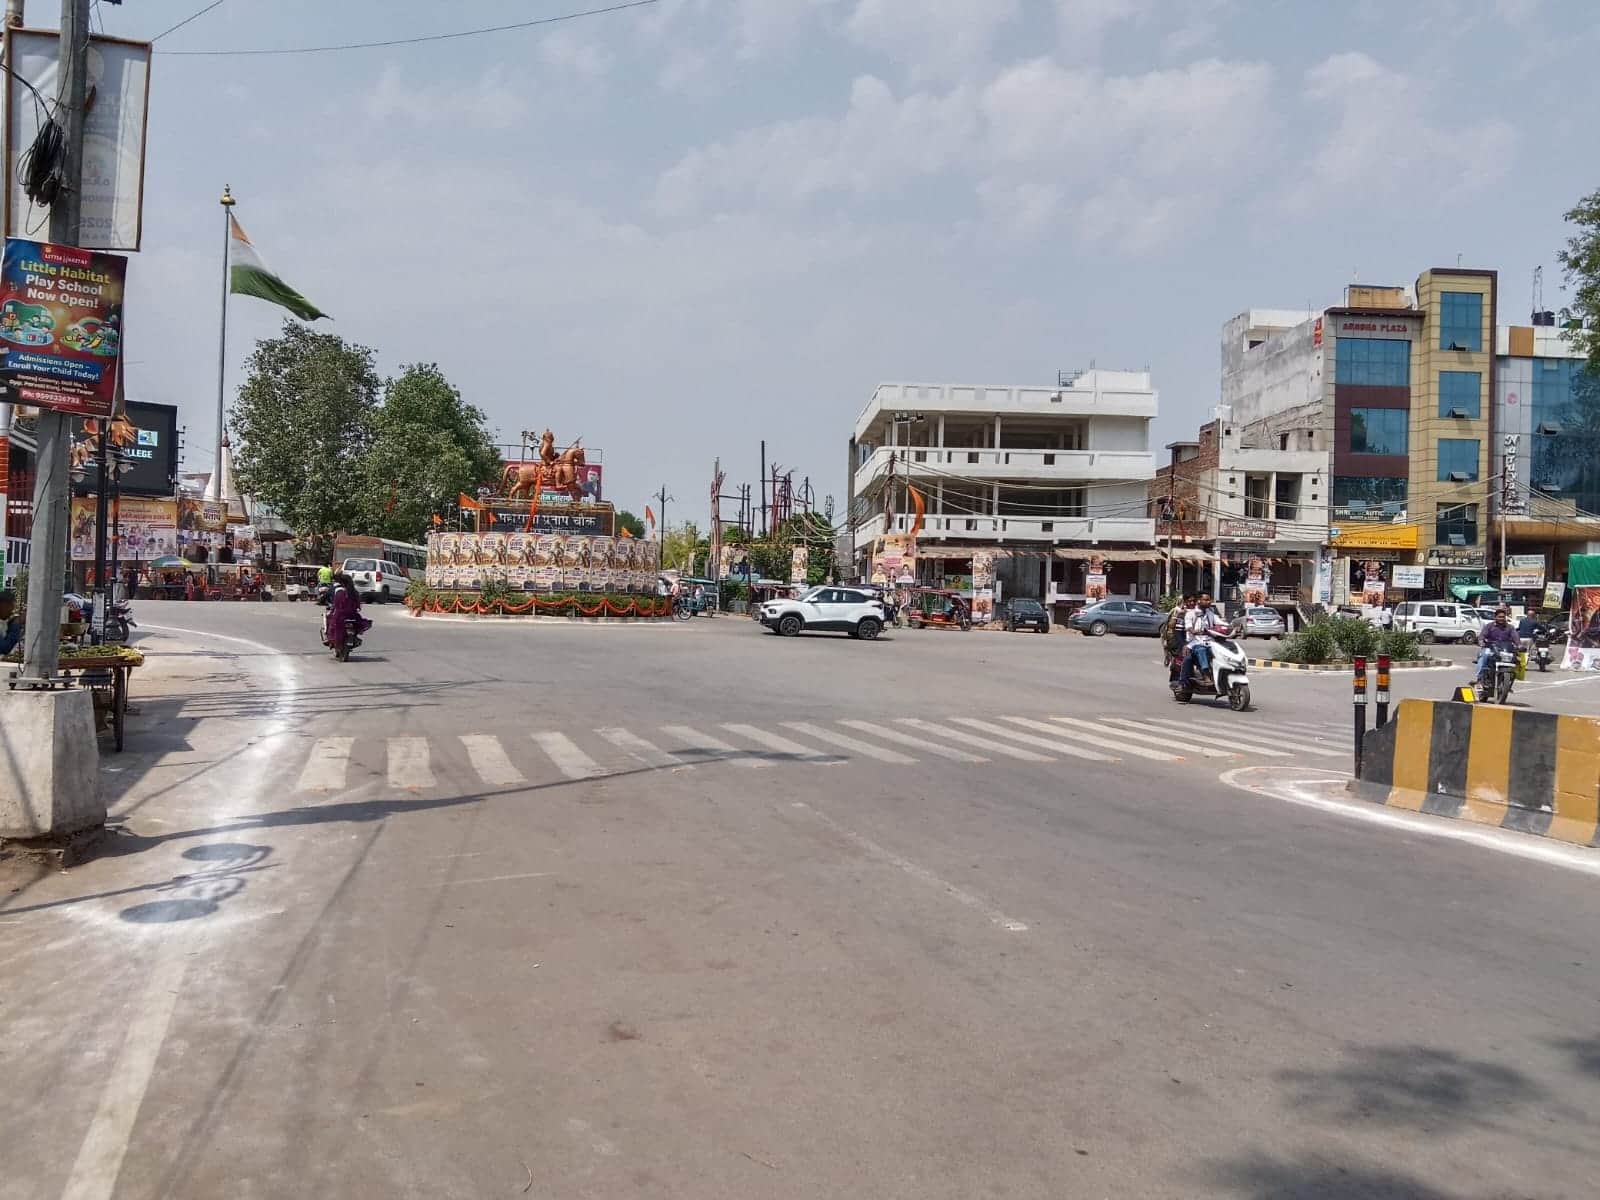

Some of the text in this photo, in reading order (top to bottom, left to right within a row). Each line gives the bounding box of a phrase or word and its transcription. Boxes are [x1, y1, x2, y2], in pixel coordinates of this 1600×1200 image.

[20, 260, 111, 284] Little Habitat
[25, 274, 103, 295] Play School
[27, 288, 98, 308] Now Open!
[8, 360, 31, 370] Enroll
[32, 364, 50, 372] Your
[51, 366, 72, 376] Child
[18, 354, 62, 366] Admissions
[64, 360, 84, 370] Open
